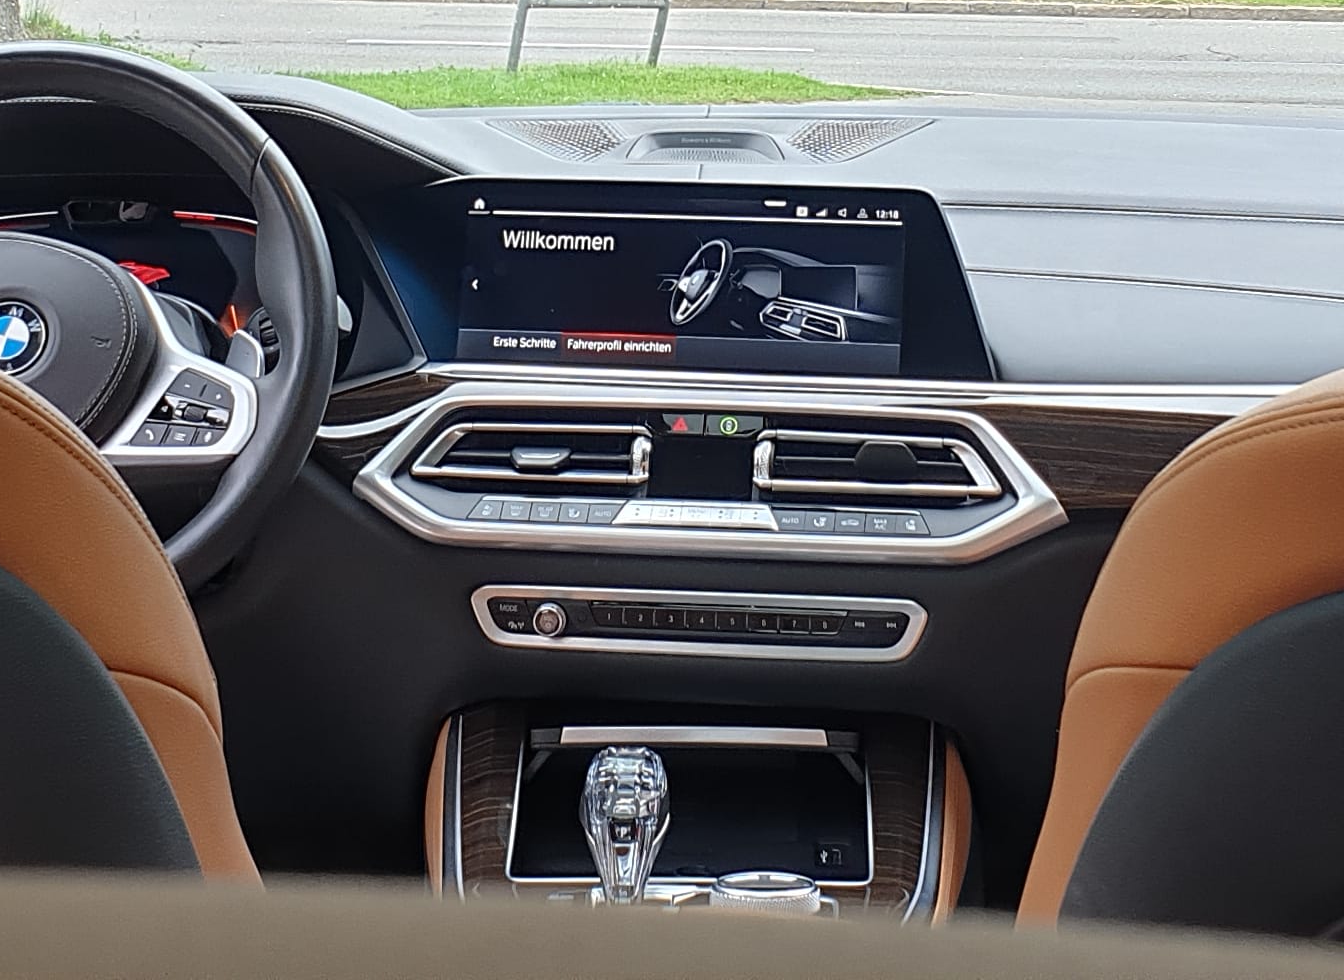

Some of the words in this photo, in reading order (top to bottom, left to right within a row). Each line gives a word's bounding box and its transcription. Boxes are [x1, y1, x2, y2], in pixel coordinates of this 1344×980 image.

[502, 229, 615, 251] Willkommen
[493, 336, 517, 348] Erste
[519, 337, 557, 350] Schritte
[567, 338, 622, 353] Fahrerprofil
[623, 340, 672, 354] einrichten
[781, 516, 800, 524] AUTO
[499, 603, 518, 612] MODE
